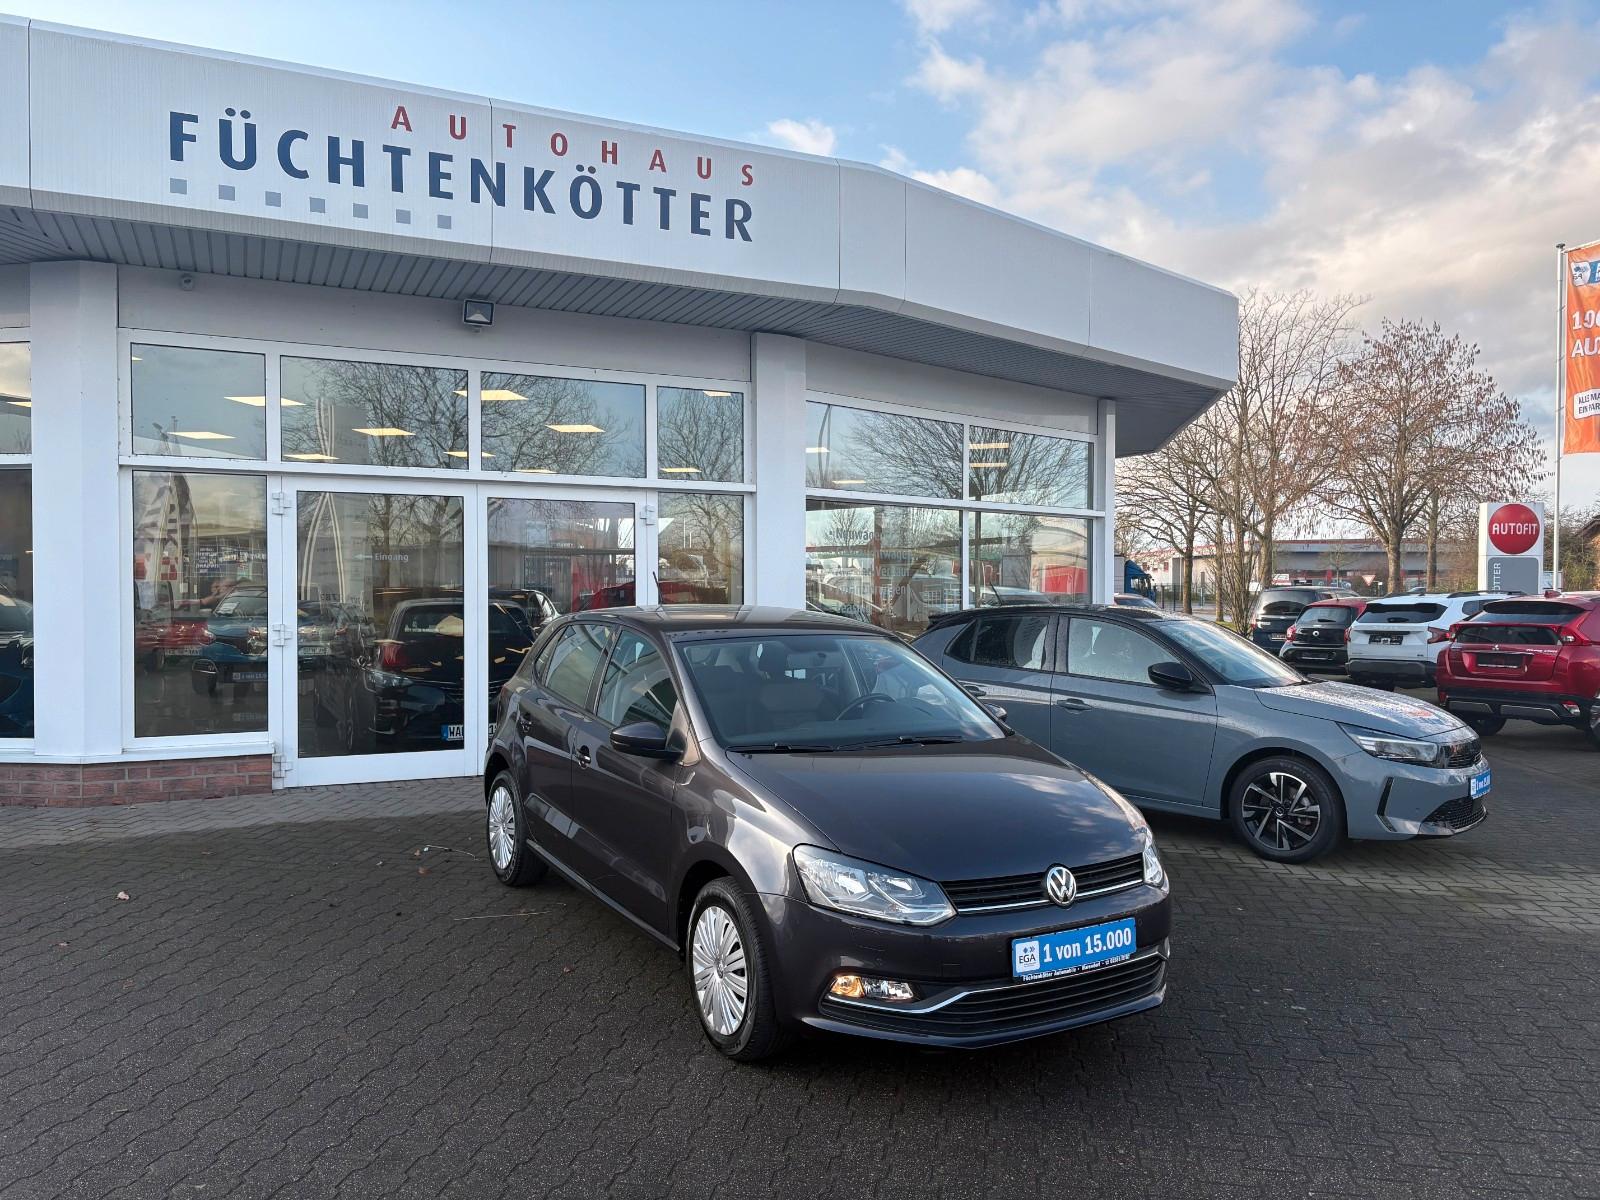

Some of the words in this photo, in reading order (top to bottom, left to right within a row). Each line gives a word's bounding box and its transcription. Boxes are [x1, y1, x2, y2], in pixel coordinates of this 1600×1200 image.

[391, 105, 754, 187] AUTOHAUS
[169, 107, 754, 243] FÜCHTENKÖTTER
[1571, 336, 1600, 358] AU
[1492, 523, 1537, 535] AUTOFIT
[1018, 953, 1037, 964] EGA
[1043, 943, 1053, 963] 1
[1056, 942, 1082, 961] von
[1085, 927, 1132, 955] 15.000
